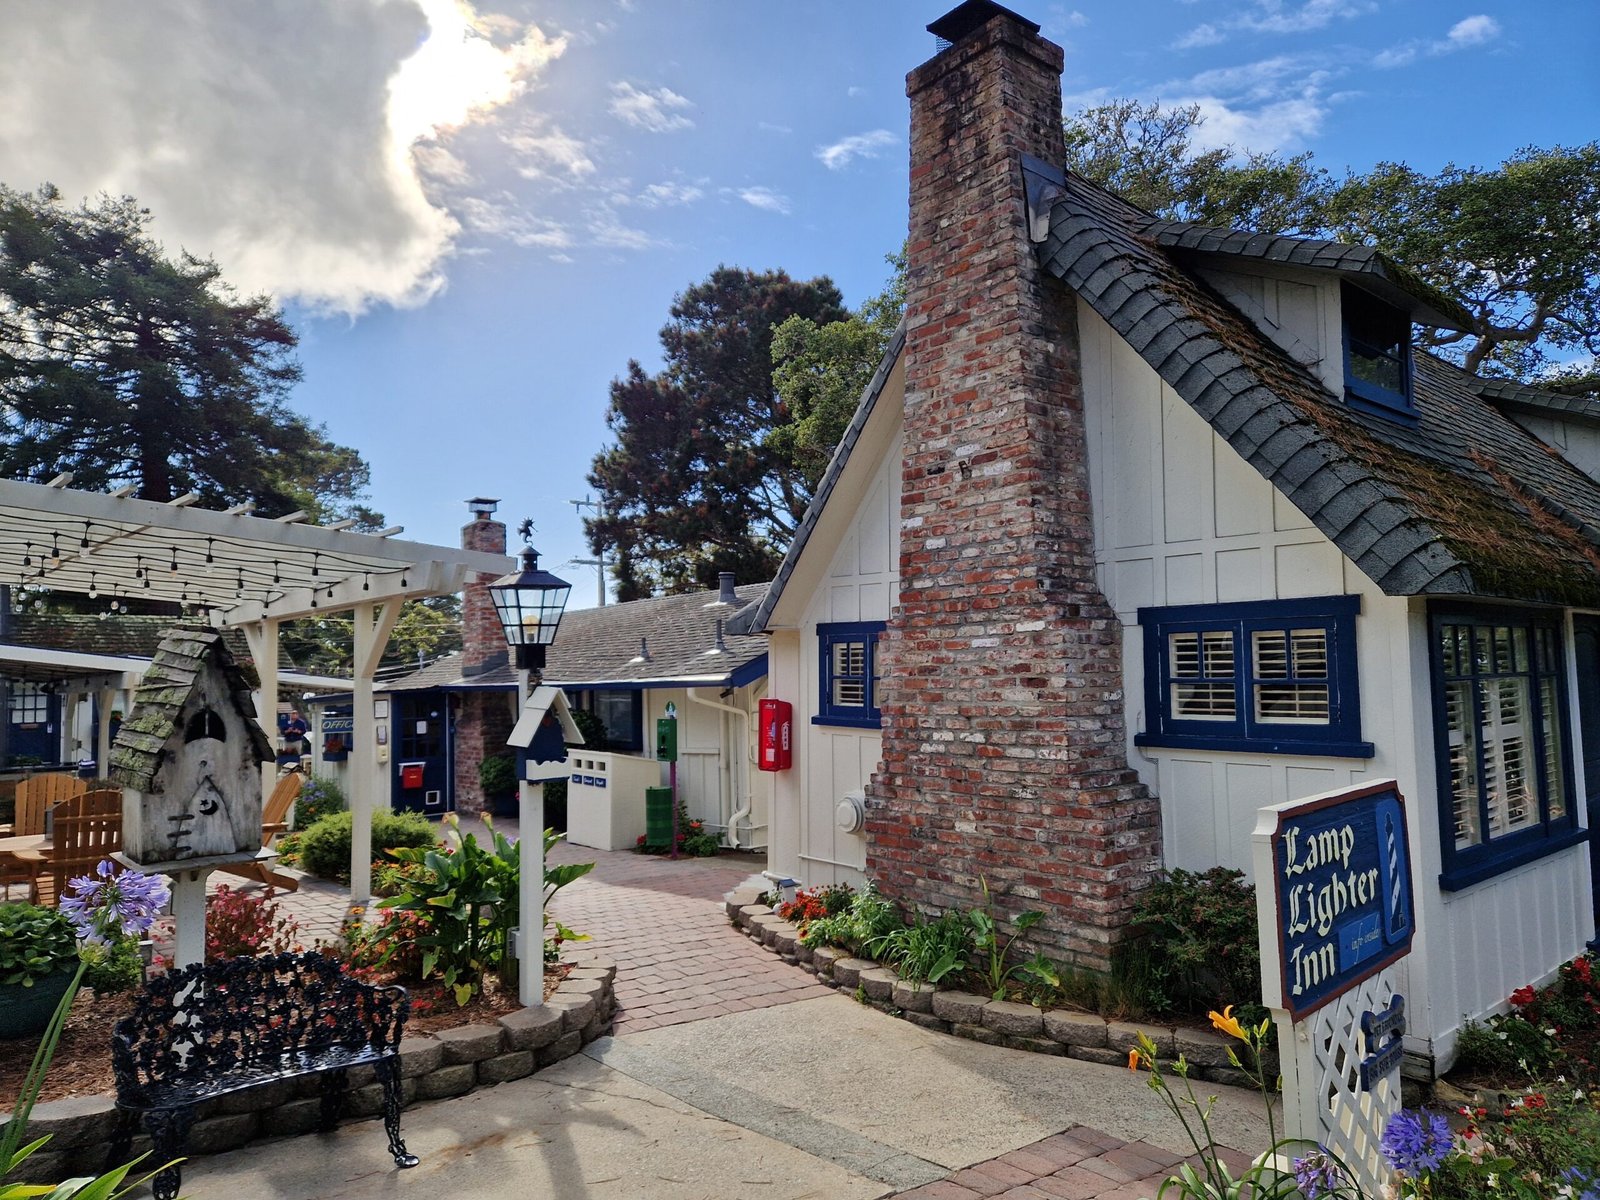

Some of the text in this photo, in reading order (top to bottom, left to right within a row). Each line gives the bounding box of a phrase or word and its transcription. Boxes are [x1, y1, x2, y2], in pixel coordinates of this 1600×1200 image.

[322, 720, 353, 729] OFFIC
[1282, 824, 1354, 880] Lamp
[1287, 867, 1379, 938] Lighter
[1290, 942, 1336, 996] Inn
